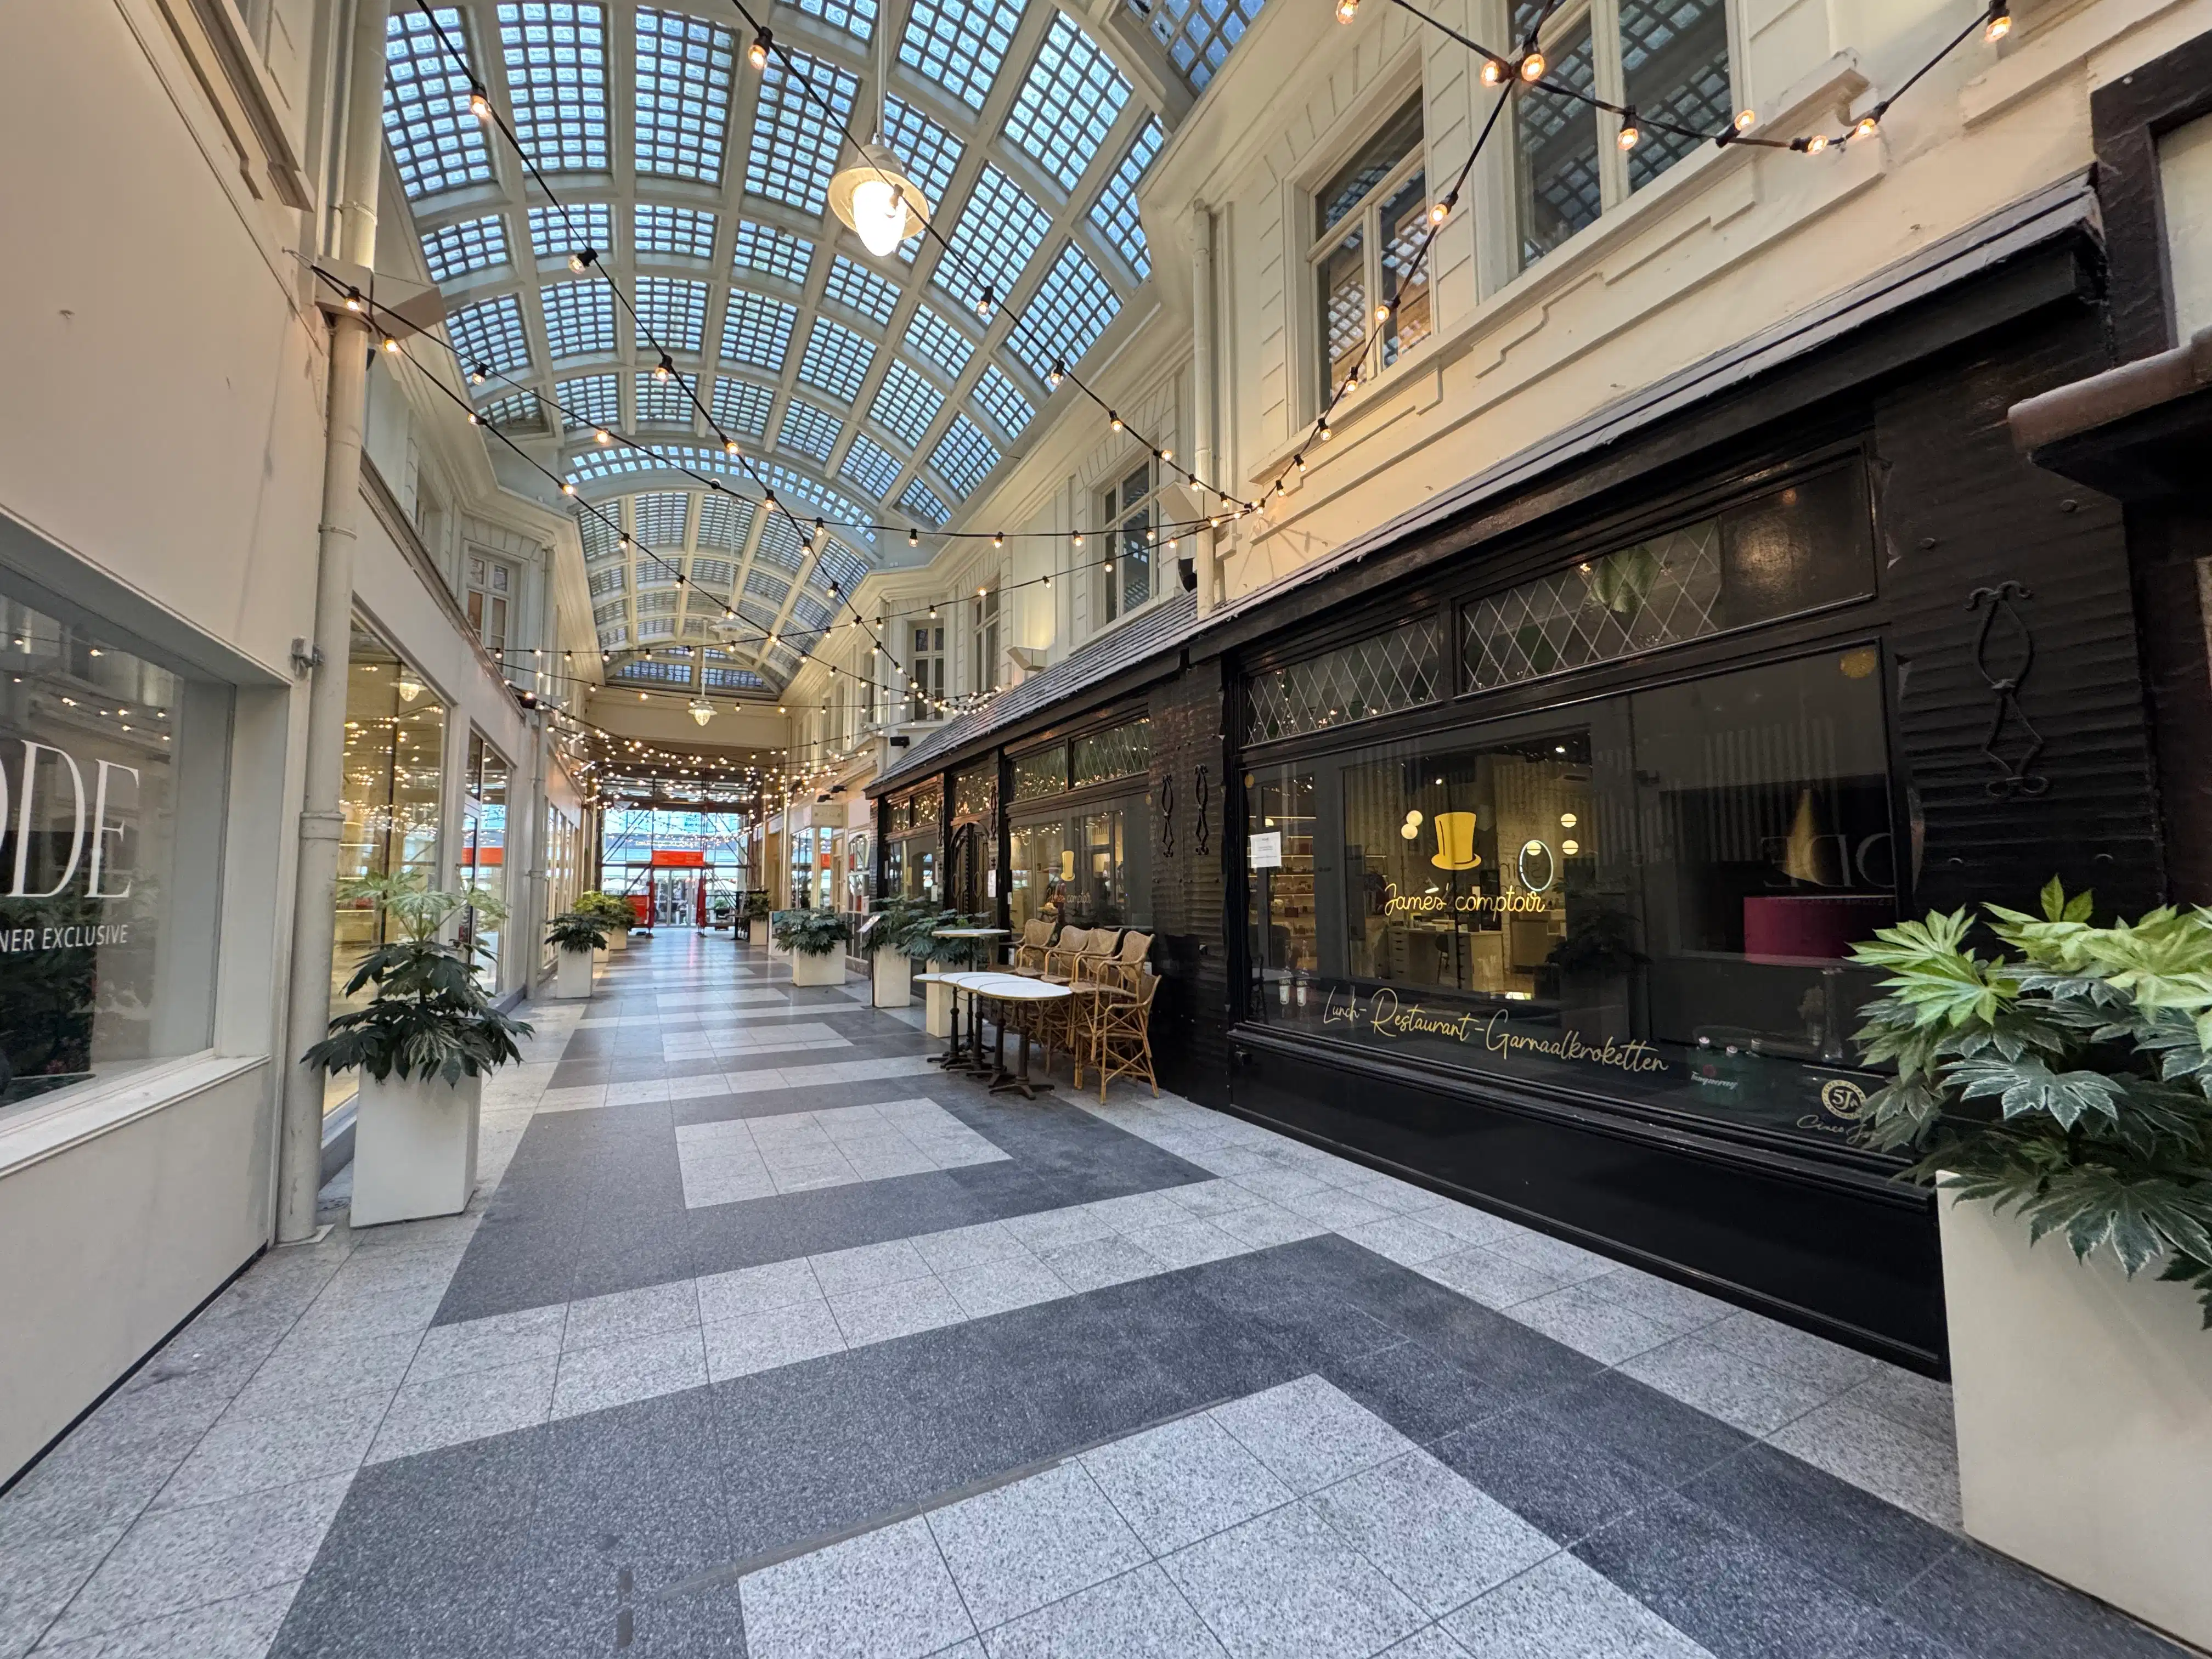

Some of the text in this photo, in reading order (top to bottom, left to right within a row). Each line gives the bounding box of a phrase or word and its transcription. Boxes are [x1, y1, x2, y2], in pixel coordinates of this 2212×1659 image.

[0, 739, 139, 898] DE
[1455, 885, 1546, 922] comptoir
[41, 924, 129, 950] EXCLUSIVE
